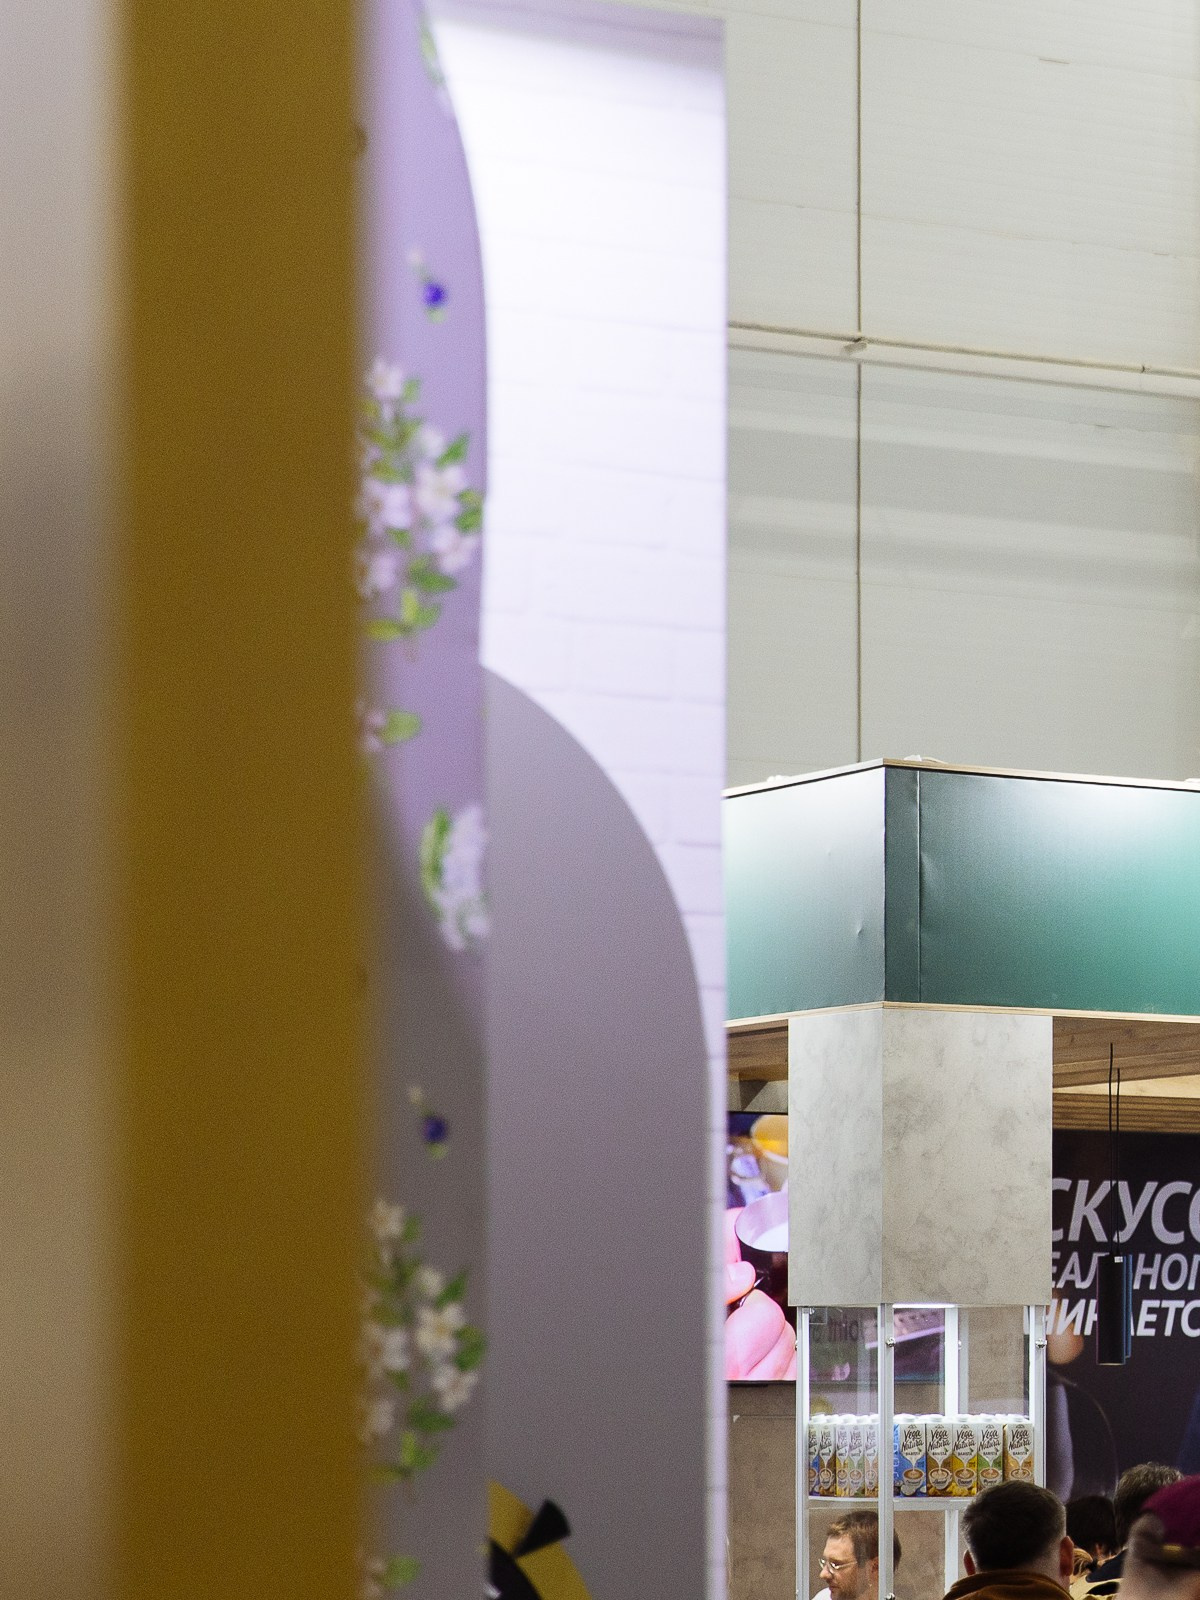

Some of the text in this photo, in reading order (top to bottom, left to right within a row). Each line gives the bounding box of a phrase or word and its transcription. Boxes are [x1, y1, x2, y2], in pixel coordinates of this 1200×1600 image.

[904, 1429, 921, 1441] Vega
[931, 1429, 948, 1441] Vega
[956, 1429, 974, 1441] Vega
[981, 1429, 999, 1441] Vega
[1012, 1429, 1029, 1441] Vega
[902, 1439, 924, 1451] Natura
[928, 1438, 950, 1451] Natura
[954, 1439, 976, 1451] Natura
[979, 1439, 1001, 1451] Natura
[1009, 1439, 1031, 1451] Natura
